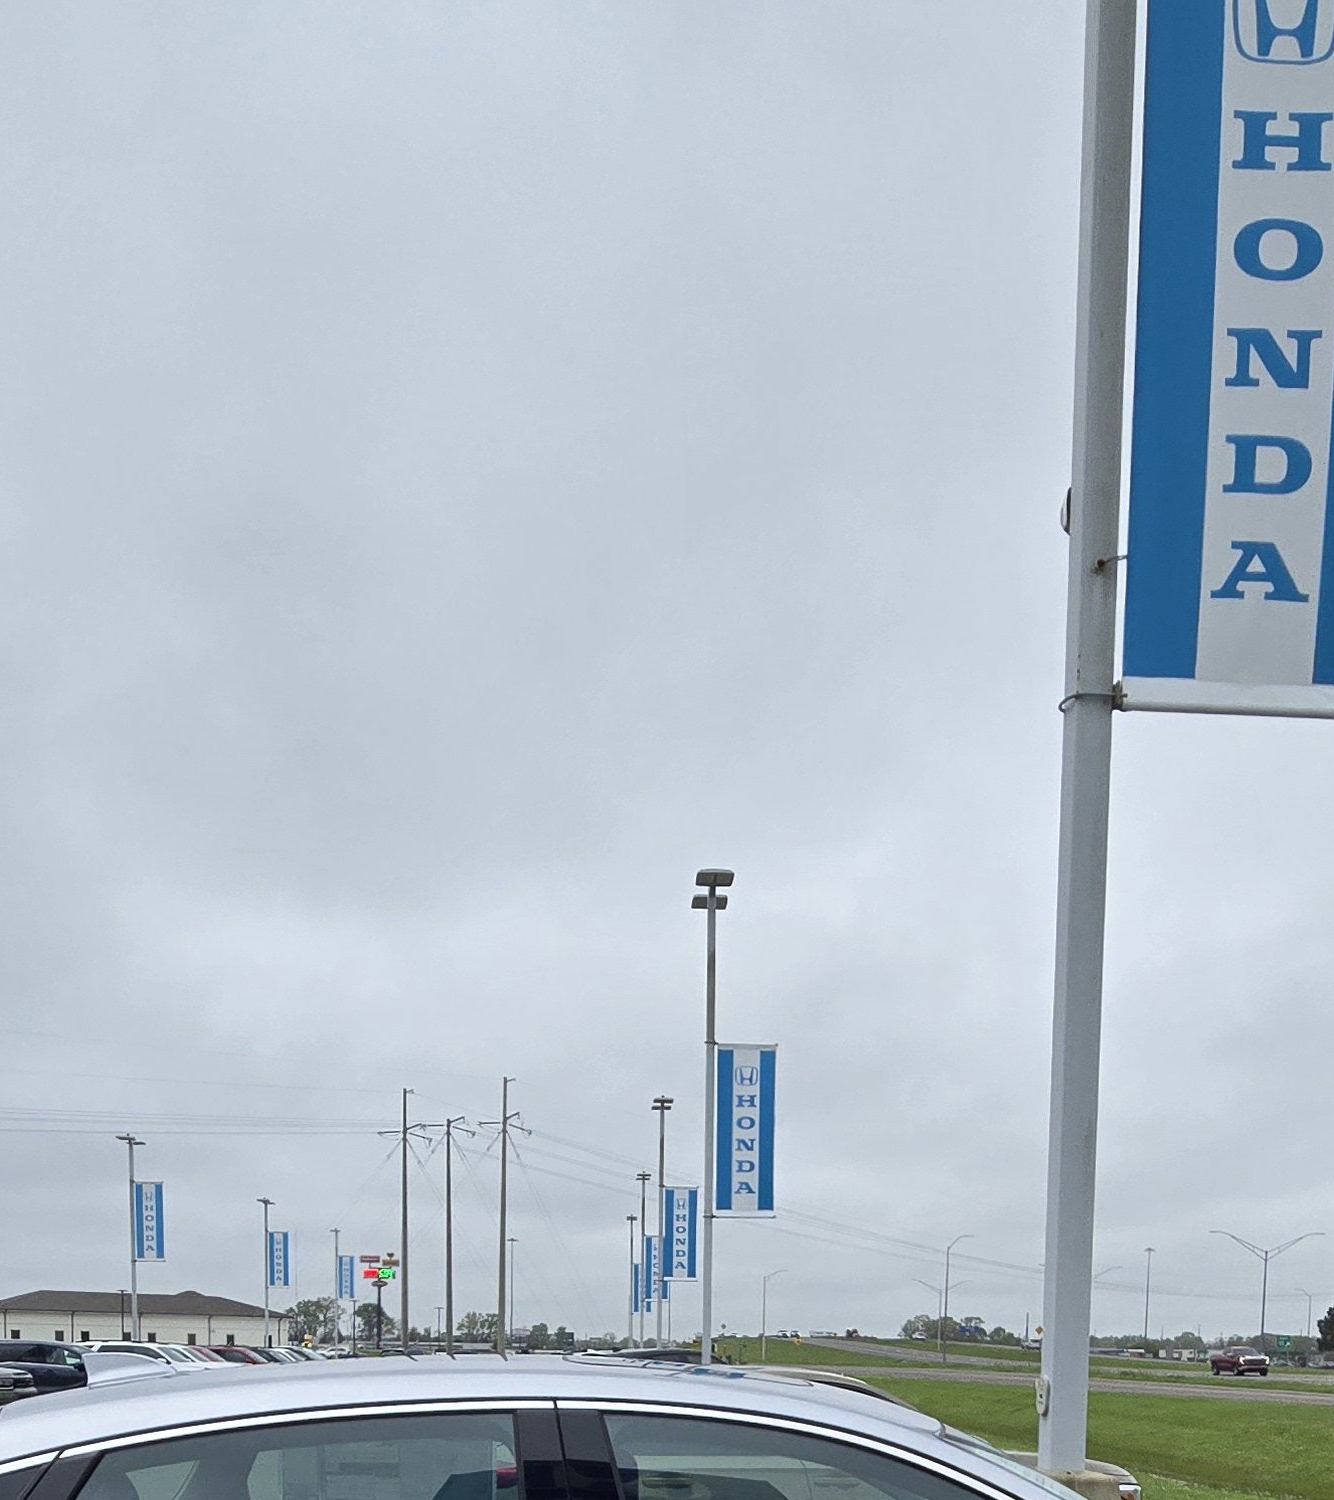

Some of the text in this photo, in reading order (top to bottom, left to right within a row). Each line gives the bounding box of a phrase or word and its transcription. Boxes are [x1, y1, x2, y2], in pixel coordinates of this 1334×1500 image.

[1210, 109, 1333, 603] HONDA
[735, 1094, 757, 1194] HONDA
[144, 1204, 156, 1252] HONDA
[675, 1213, 687, 1270] HONDA
